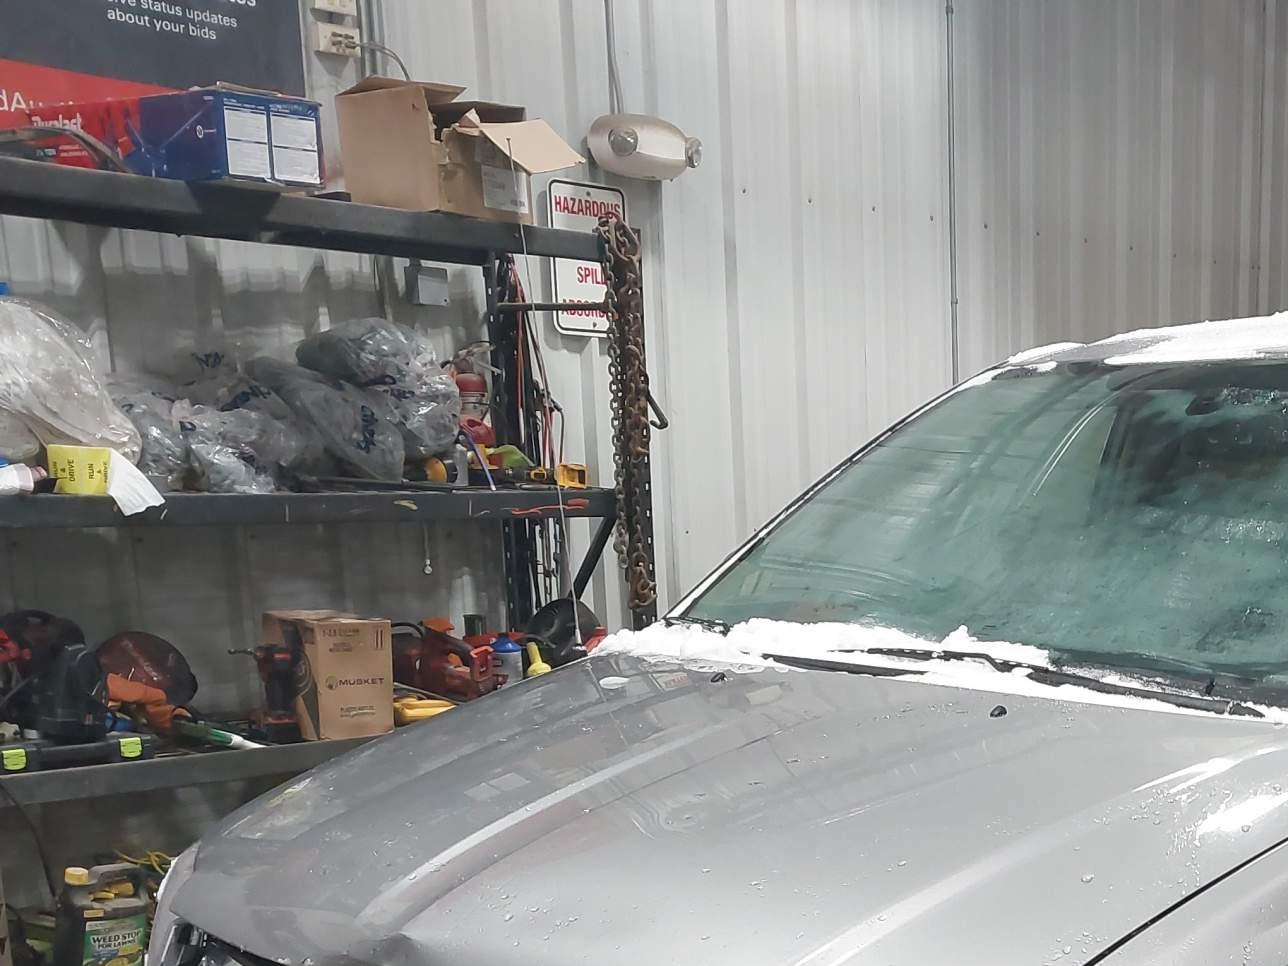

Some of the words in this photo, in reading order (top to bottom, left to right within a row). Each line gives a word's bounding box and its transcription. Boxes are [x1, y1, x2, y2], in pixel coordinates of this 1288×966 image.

[107, 7, 150, 28] about
[153, 18, 186, 35] your
[188, 23, 217, 40] bids
[140, 0, 182, 16] status
[186, 7, 238, 28] updates
[554, 195, 620, 219] HAZARDOUS
[67, 458, 76, 482] DRIVE
[91, 934, 121, 944] WEED
[121, 928, 142, 940] STOP
